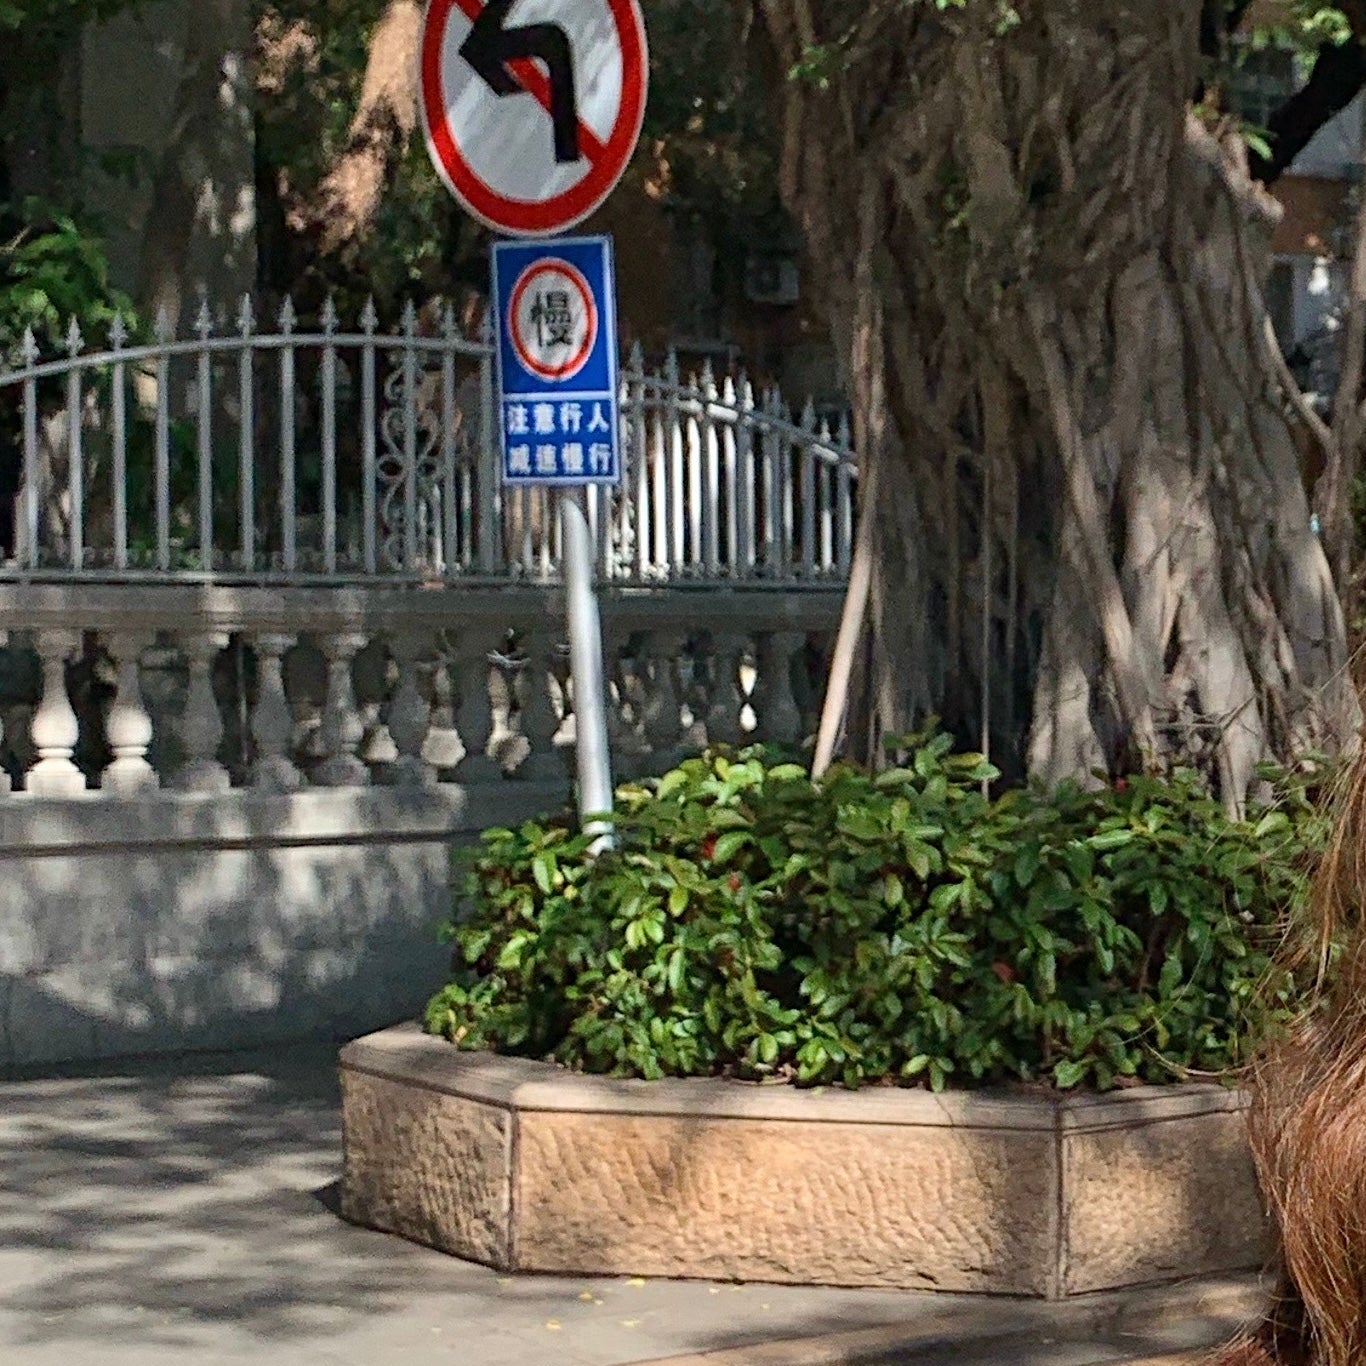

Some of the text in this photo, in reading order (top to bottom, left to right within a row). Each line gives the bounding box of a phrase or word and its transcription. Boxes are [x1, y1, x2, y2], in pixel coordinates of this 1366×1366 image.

[530, 290, 573, 348] 慢
[507, 402, 610, 435] 注意行人
[508, 442, 611, 475] 减速慢行
